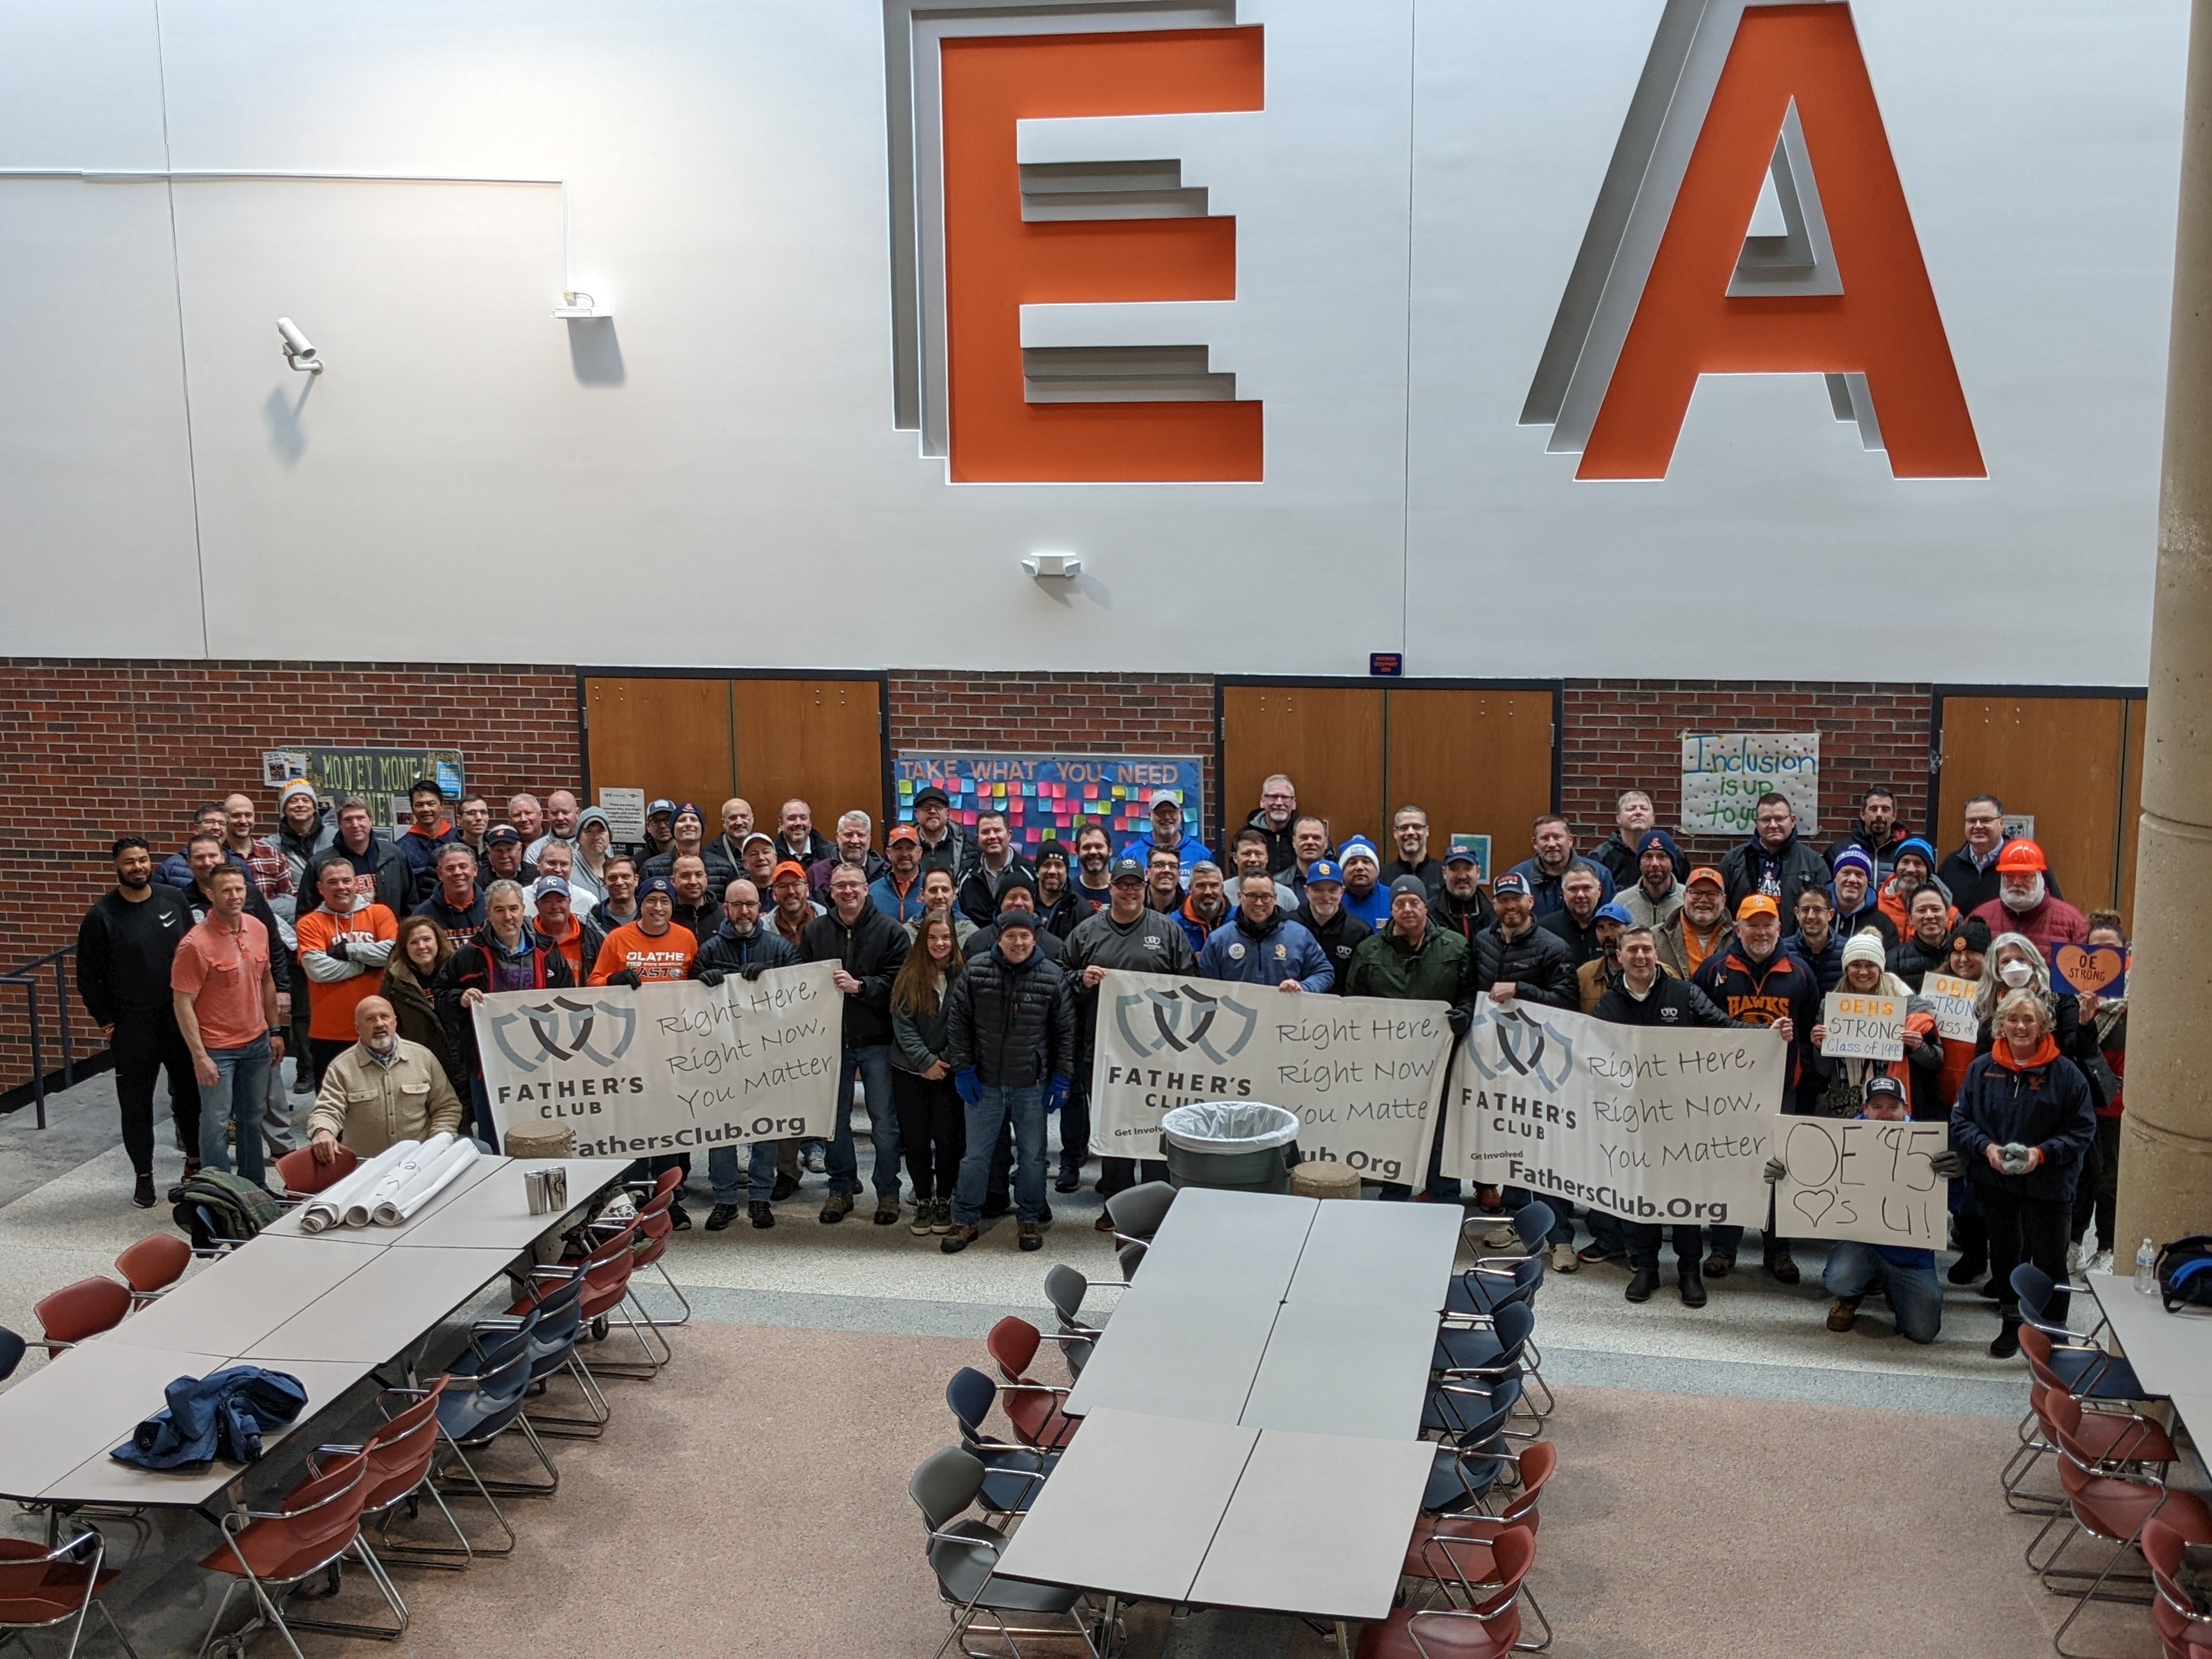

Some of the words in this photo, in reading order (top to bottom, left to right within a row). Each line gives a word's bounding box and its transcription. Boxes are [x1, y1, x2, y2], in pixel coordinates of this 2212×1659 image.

[1683, 735, 1818, 775] Inclusion
[322, 754, 374, 791] MONEY
[900, 760, 958, 780] TAKE
[970, 760, 1038, 781] WHAT
[1056, 762, 1101, 783] YOU
[1118, 764, 1178, 784] NEED
[1720, 776, 1738, 797] is
[1743, 780, 1774, 797] up
[1704, 800, 1736, 826] to
[626, 951, 685, 961] OLATHE
[2079, 955, 2097, 970] OE
[2069, 968, 2106, 982] STRONG
[1937, 978, 1976, 998] OEH
[657, 997, 742, 1037] Right
[751, 980, 818, 1015] Here,
[1727, 996, 1790, 1018] HAWKS
[1839, 998, 1894, 1015] OEHS
[1925, 995, 1975, 1019] TRON
[1276, 1019, 1361, 1049] Right
[1372, 1018, 1439, 1040] Here,
[1829, 1017, 1905, 1040] STRONG
[666, 1039, 752, 1076] Right
[761, 1018, 827, 1051] Now,
[1827, 1039, 1861, 1053] Class
[1865, 1041, 1878, 1054] of
[1881, 1042, 1903, 1057] 1995
[1277, 1059, 1362, 1092] Right
[1375, 1059, 1434, 1082] Now
[1588, 1052, 1666, 1088] Right
[1679, 1048, 1755, 1074] Here,
[498, 1076, 644, 1104] FATHER'S
[678, 1085, 735, 1120] You
[745, 1054, 834, 1094] Matter
[1109, 1066, 1251, 1097] FATHER'S
[540, 1102, 602, 1119] CLUB
[1347, 1098, 1427, 1121] Matte
[1462, 1088, 1577, 1130] FATHER'S
[1593, 1097, 1674, 1132] Right
[1686, 1092, 1760, 1119] Now,
[1134, 1125, 1164, 1135] Involv
[1493, 1118, 1545, 1140] CLUB
[1483, 1150, 1523, 1160] Involved
[1601, 1144, 1651, 1177] You
[1662, 1136, 1767, 1166] Matter
[1785, 1122, 1865, 1187] OE
[1876, 1126, 1940, 1192] '95
[1509, 1160, 1728, 1224] FathersClub.Org
